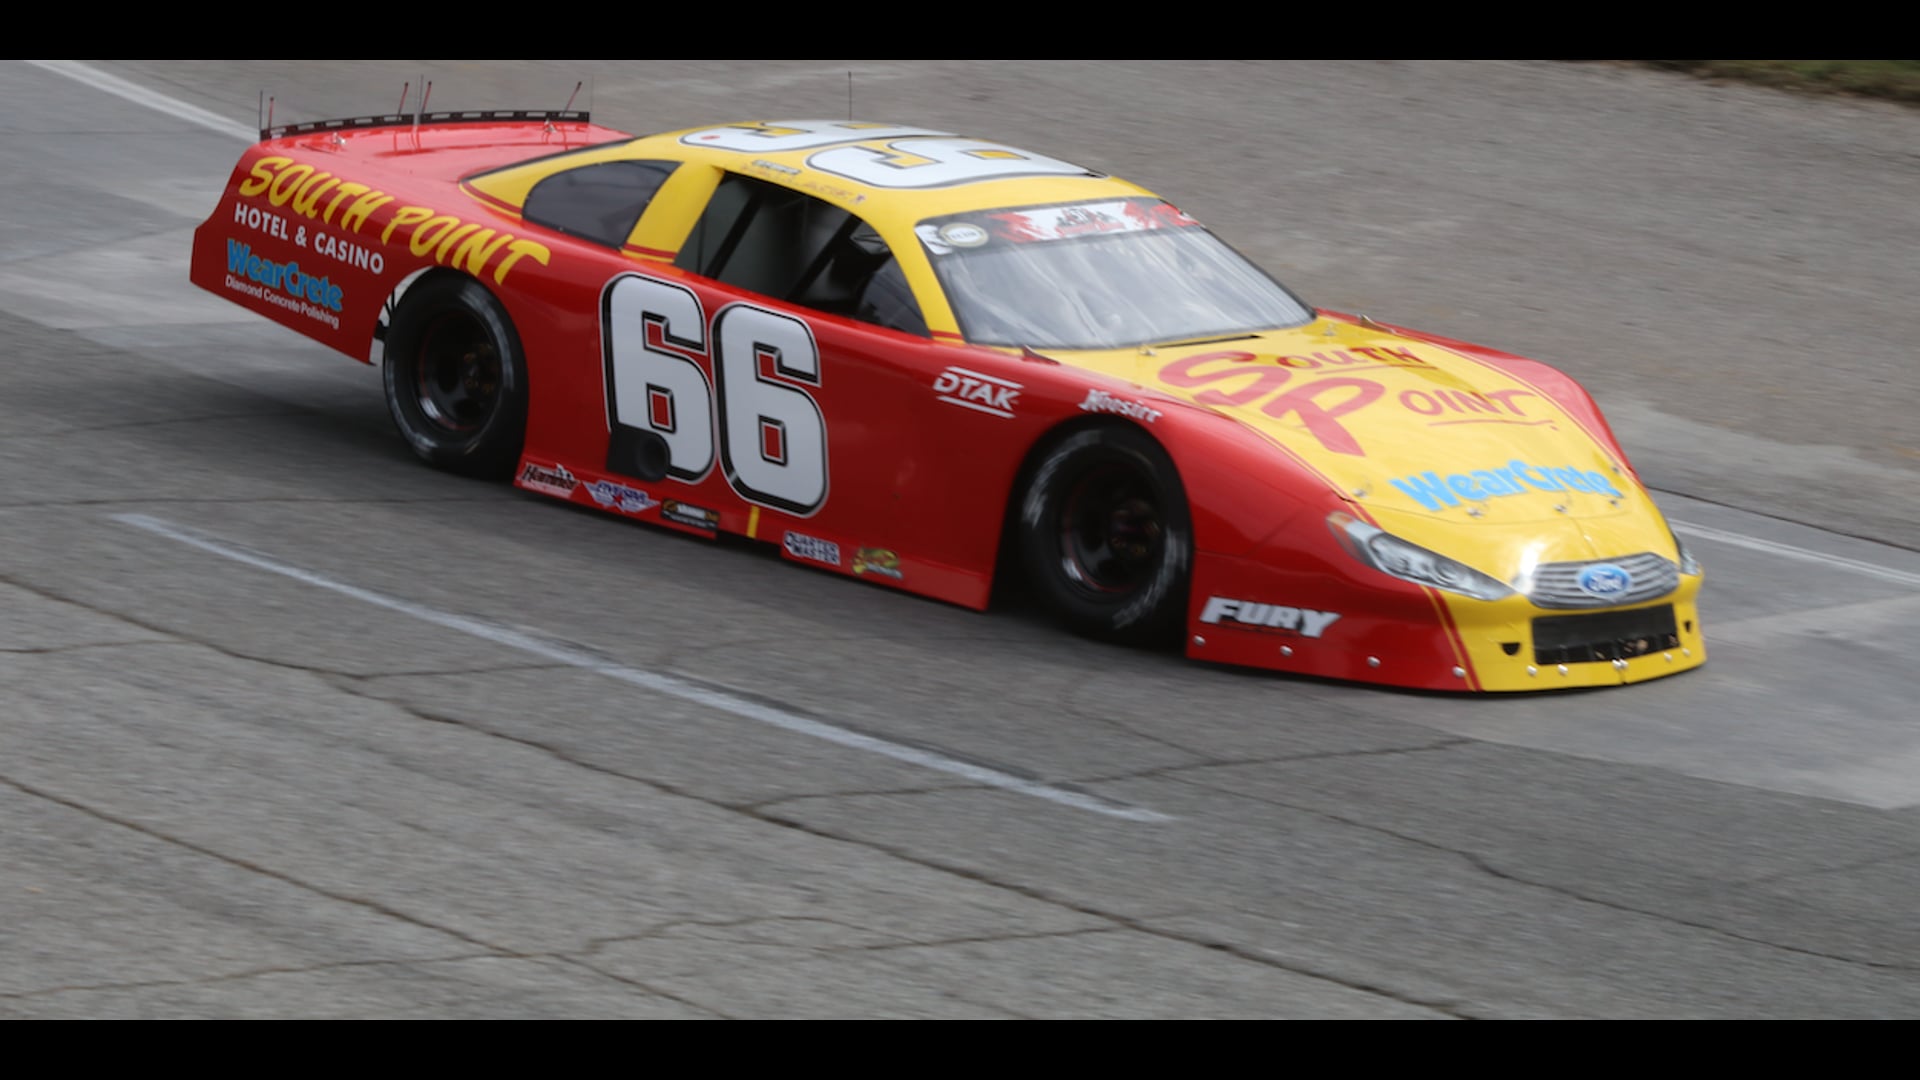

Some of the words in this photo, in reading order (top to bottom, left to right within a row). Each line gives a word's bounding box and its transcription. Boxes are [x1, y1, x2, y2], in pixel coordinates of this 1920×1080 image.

[234, 202, 288, 240] HOTEL
[295, 226, 307, 247] &
[314, 232, 384, 274] CASINO
[239, 156, 394, 234] SOUTH
[382, 206, 551, 286] POINT
[225, 275, 263, 298] Diamond
[263, 287, 299, 313] Concrete
[300, 302, 339, 330] Polishing
[227, 238, 343, 312] WearCrete
[599, 271, 830, 518] 66
[933, 372, 1021, 411] DTAK
[1390, 460, 1624, 512] WearCrete
[1200, 596, 1342, 638] FURY
